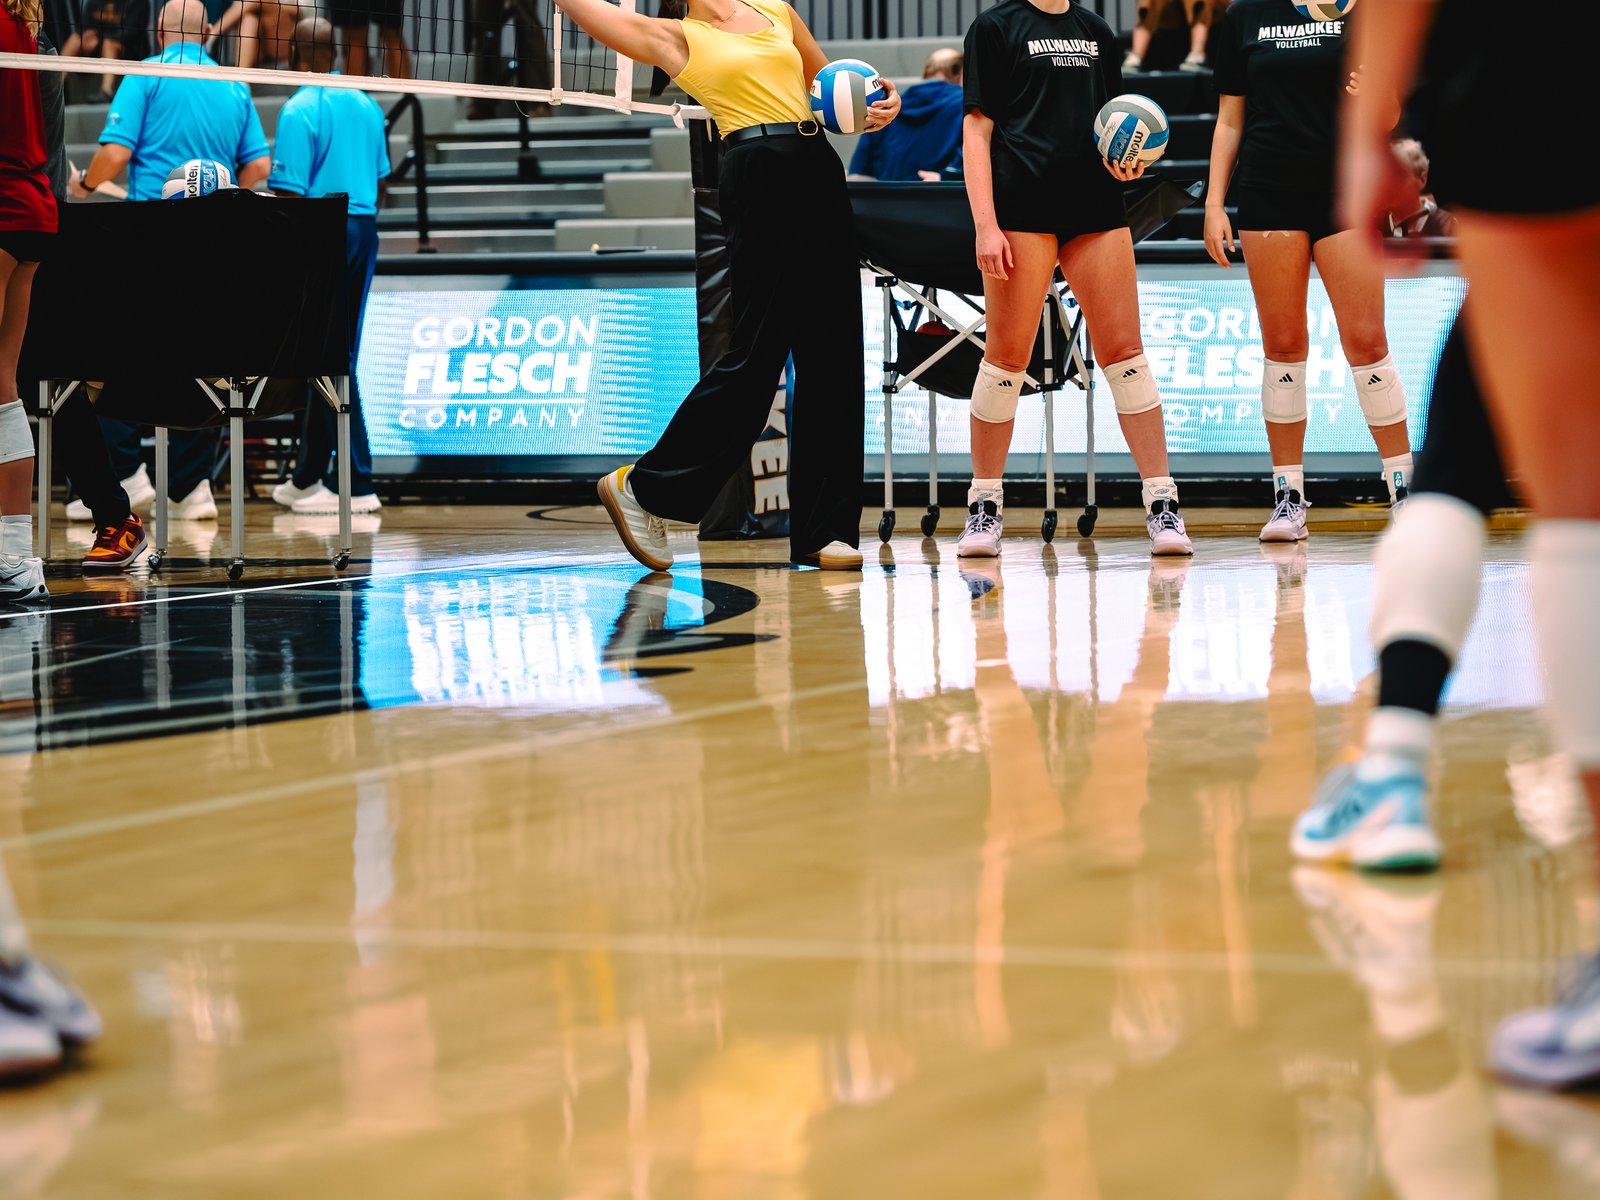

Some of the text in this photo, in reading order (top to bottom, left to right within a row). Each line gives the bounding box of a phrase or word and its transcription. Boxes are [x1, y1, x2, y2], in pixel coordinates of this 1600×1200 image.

[1258, 21, 1342, 40] MILWAUKEE
[1027, 38, 1099, 56] MILWAUKEE
[1275, 38, 1322, 49] VOLLEYBALL
[1051, 56, 1091, 68] VOLLEYBALL
[412, 315, 598, 348] GORDON
[403, 352, 594, 394] FLESCH
[399, 408, 585, 430] COMPANY
